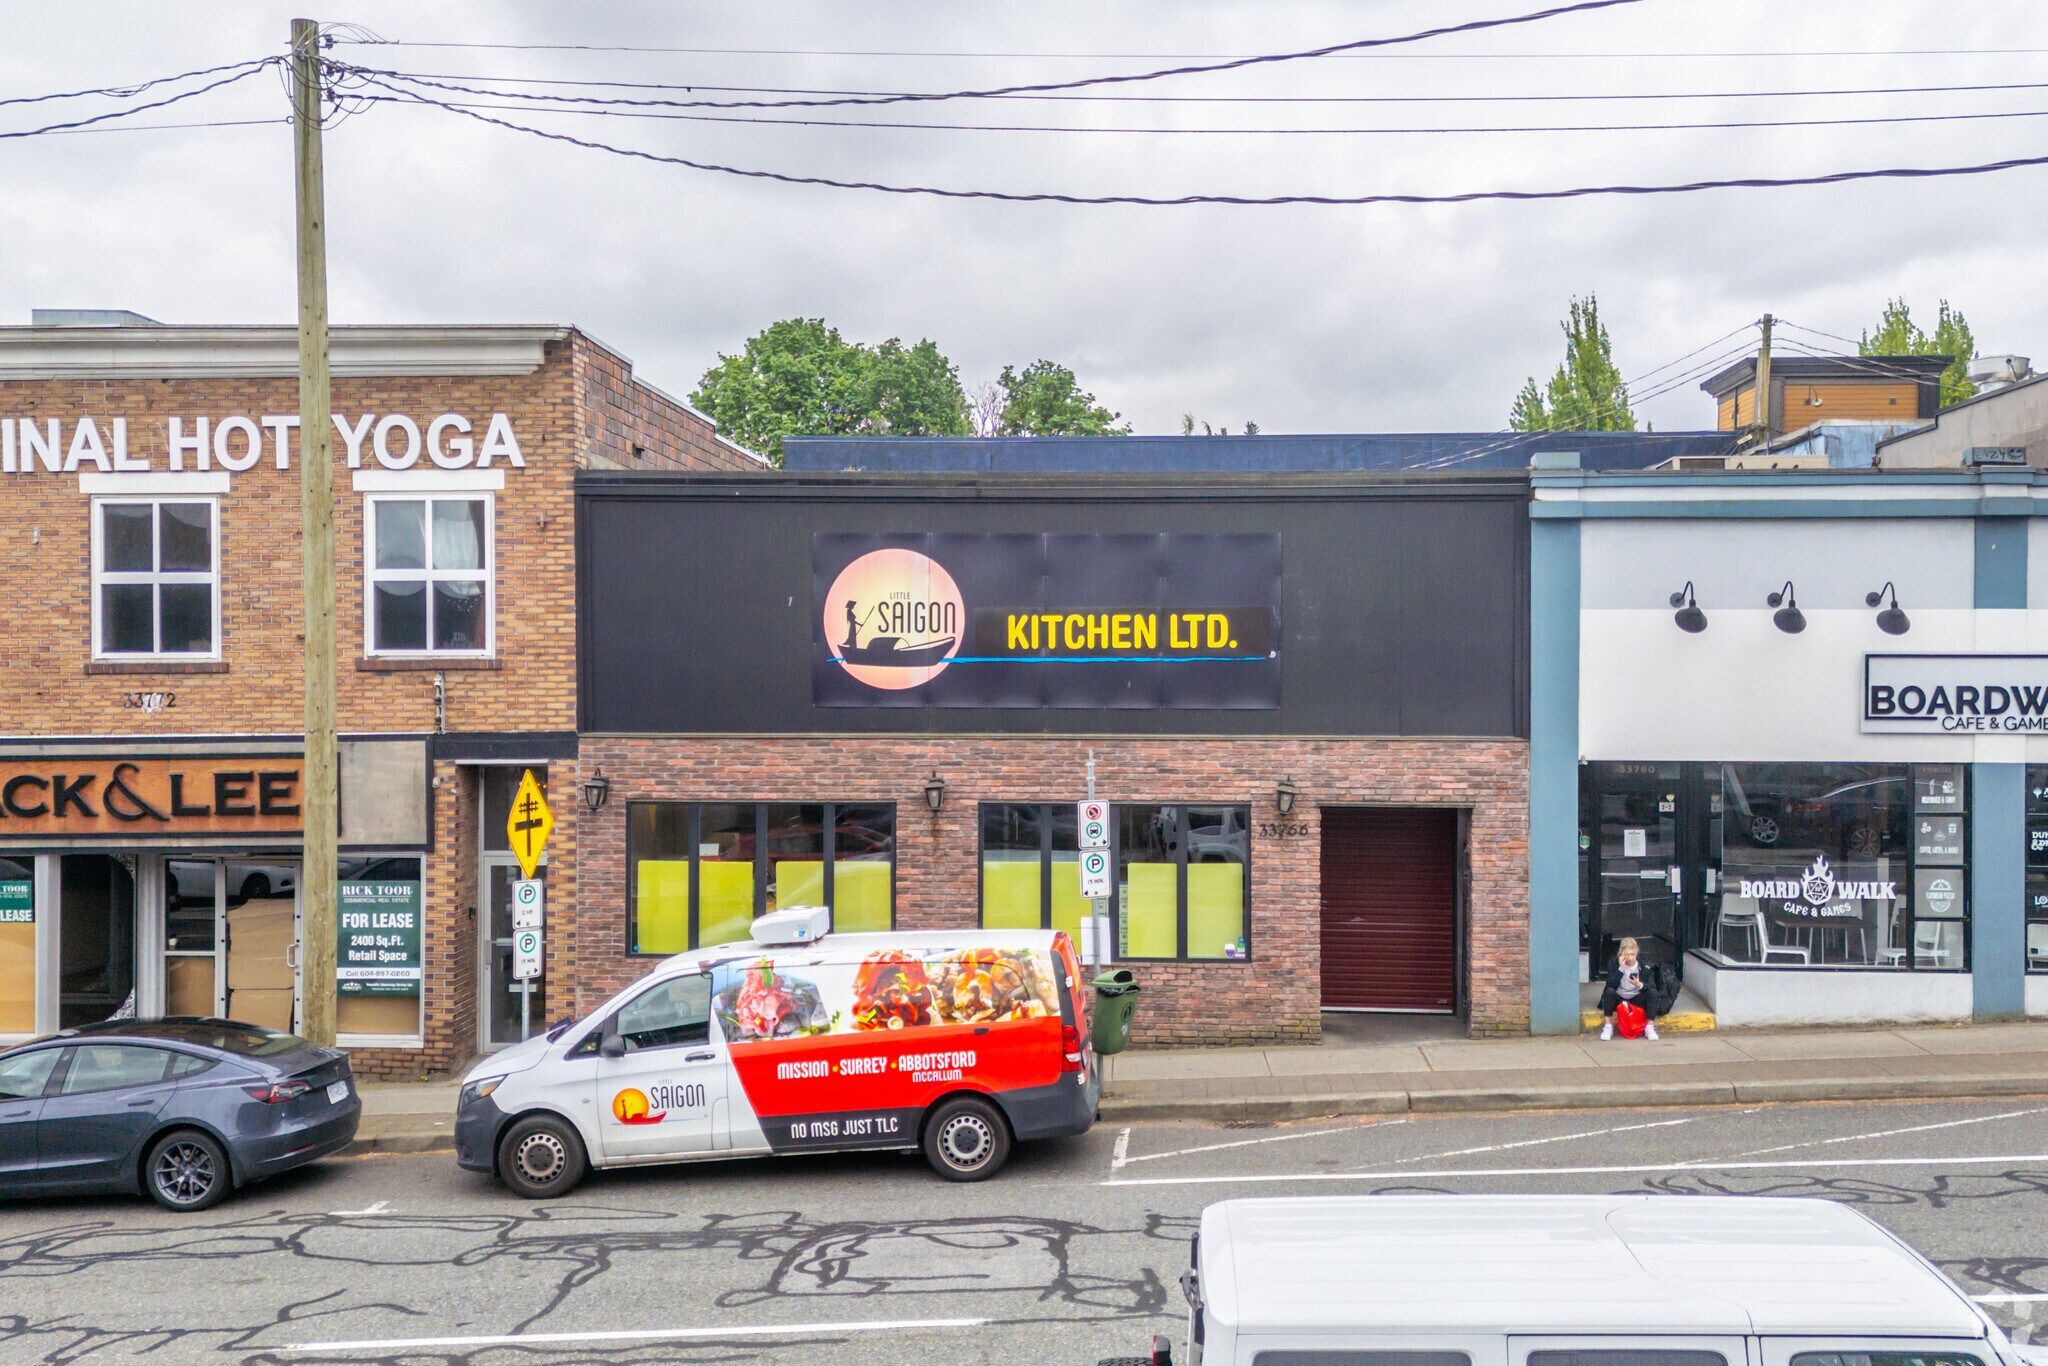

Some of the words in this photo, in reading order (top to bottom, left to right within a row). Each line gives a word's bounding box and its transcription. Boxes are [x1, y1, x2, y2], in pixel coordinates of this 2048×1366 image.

[1, 417, 150, 473] INAL
[168, 415, 300, 471] HOT
[331, 413, 526, 470] YOGA
[890, 592, 911, 600] LITTLE
[877, 601, 957, 634] SAIGON
[1007, 614, 1157, 650] KITCHEN
[1169, 614, 1238, 649] LTD.
[123, 692, 177, 708] 33772
[1942, 716, 1986, 731] CAFE
[1989, 718, 2000, 730] &
[1619, 765, 1656, 774] 33760
[0, 774, 99, 818] CK
[103, 762, 170, 822] &
[169, 770, 300, 817] LEE
[1259, 823, 1309, 840] 33766
[1092, 859, 1100, 869] P
[342, 886, 373, 895] RICK
[376, 886, 411, 895] TOOR
[524, 889, 532, 900] P
[1740, 881, 1800, 898] BOARD
[1836, 882, 1896, 899] WALK
[1, 910, 32, 921] LEASE
[1811, 906, 1818, 917] &
[1820, 903, 1852, 917] GAMES
[342, 913, 369, 928] FOR
[372, 913, 414, 928] LEASE
[351, 935, 374, 946] 2400
[525, 938, 532, 949] P
[348, 950, 376, 960] Retail
[378, 951, 407, 963] Space
[777, 1060, 829, 1079] MISSION
[839, 1057, 887, 1075] SURREY
[898, 1050, 976, 1072] ABBOTSFORD
[912, 1069, 962, 1083] MCCALLUM
[650, 1084, 706, 1109] SAIGON
[791, 1123, 807, 1139] NO
[811, 1122, 839, 1137] MSG
[842, 1119, 873, 1135] JUST
[875, 1117, 898, 1133] TLC
